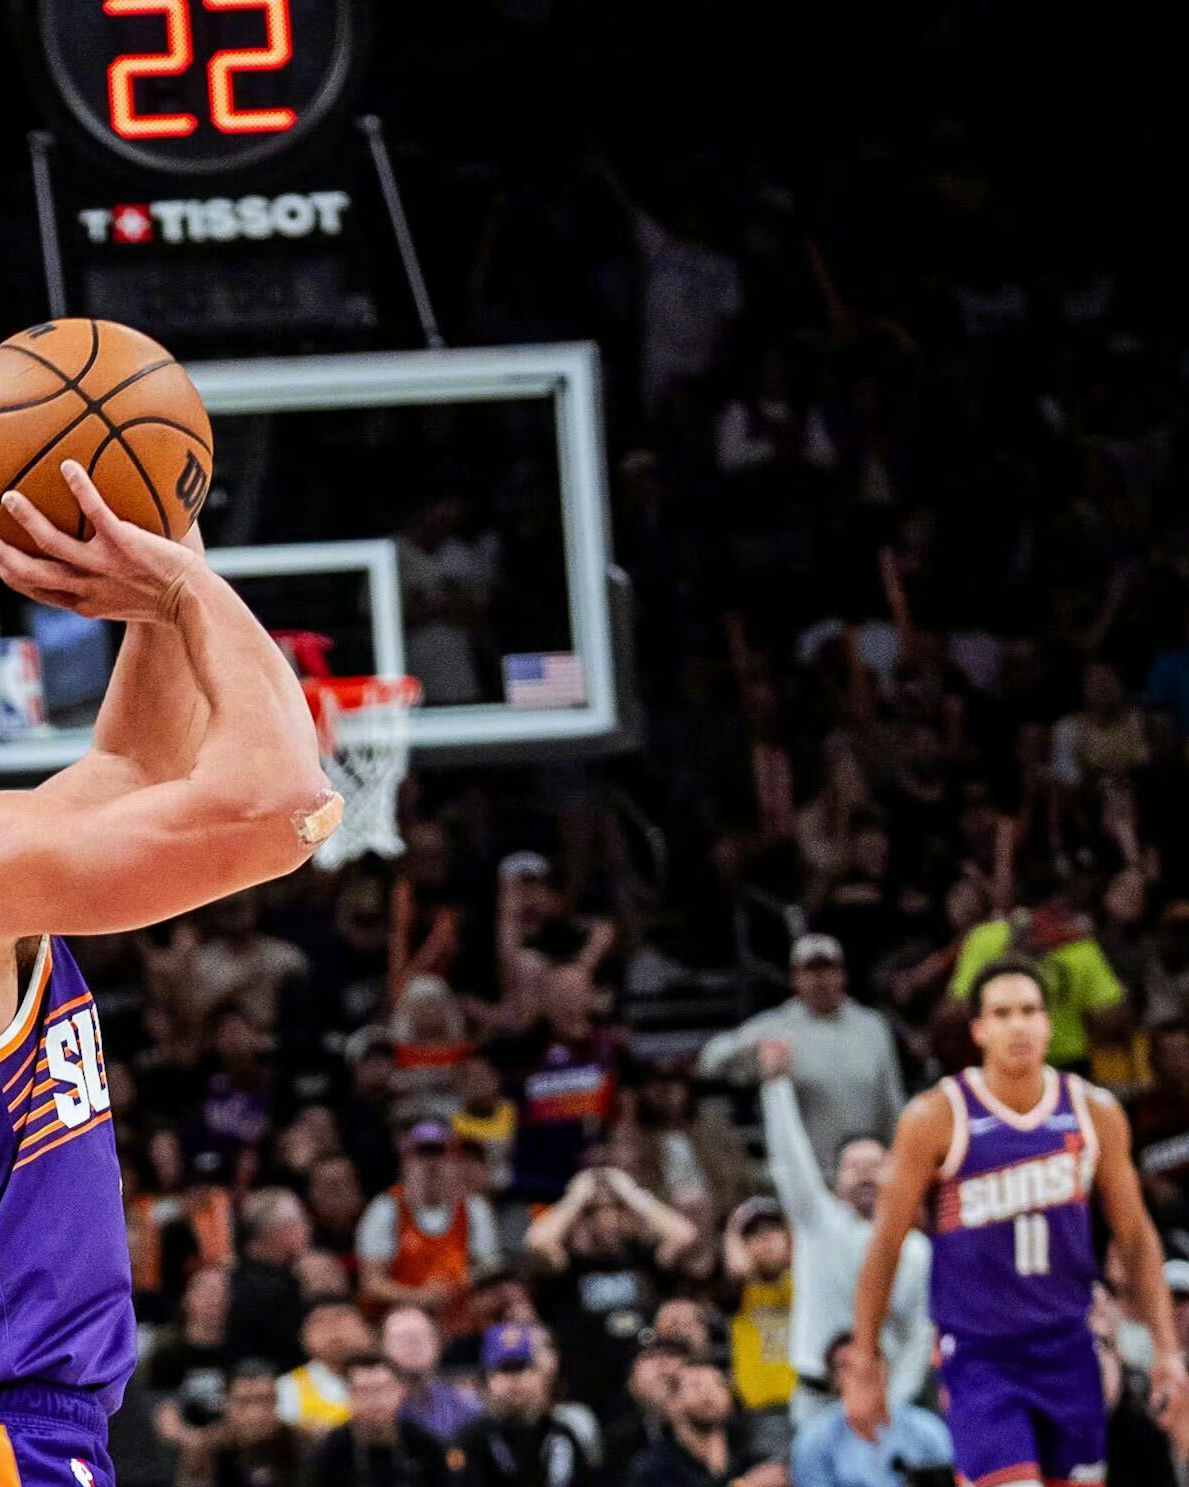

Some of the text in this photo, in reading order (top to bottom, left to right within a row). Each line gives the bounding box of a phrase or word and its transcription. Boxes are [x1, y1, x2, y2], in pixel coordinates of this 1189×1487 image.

[103, 0, 298, 140] 22
[150, 190, 351, 243] TISSOT
[1014, 1213, 1050, 1276] 11
